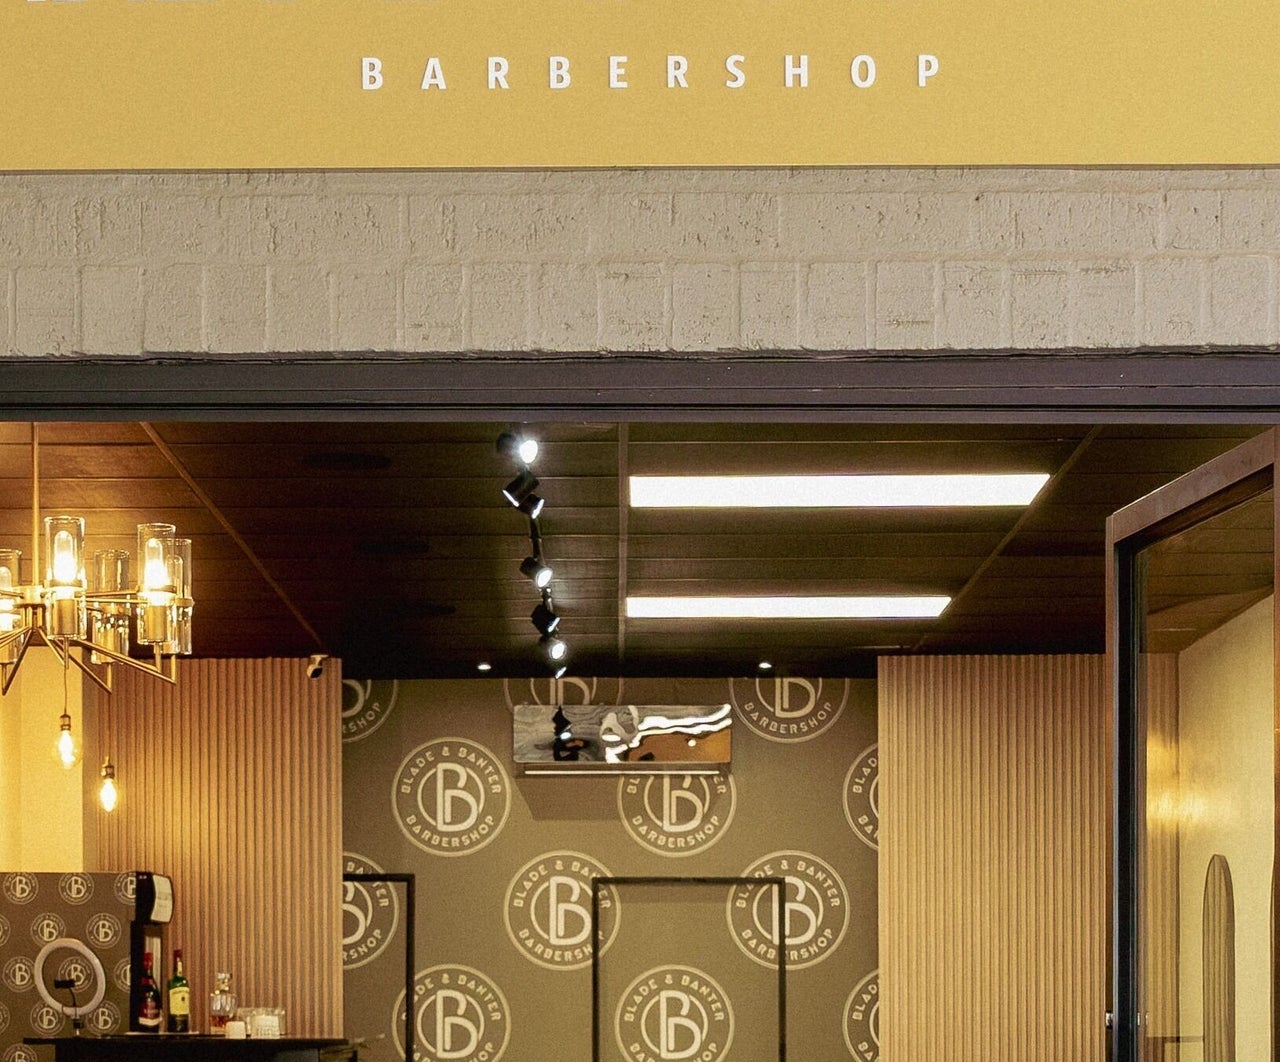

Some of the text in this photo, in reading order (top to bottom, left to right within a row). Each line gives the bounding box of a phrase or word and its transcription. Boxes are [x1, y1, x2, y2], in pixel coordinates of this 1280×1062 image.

[360, 53, 942, 91] BARBERSHOP
[744, 701, 832, 734] BARBERSHOP
[401, 751, 434, 793] BLADE
[459, 747, 501, 793] BANTER
[853, 757, 877, 794] BLAD
[406, 815, 494, 847] BARBERSHOP
[632, 815, 719, 848] BARBERSHOP
[513, 865, 548, 907] BLADE
[797, 861, 840, 907] BANTER
[742, 929, 832, 961] BARBRSHOP
[458, 974, 501, 1020] BANTER
[624, 979, 658, 1021] BLADE
[681, 975, 724, 1021] BANTER
[852, 984, 877, 1020] BLAD
